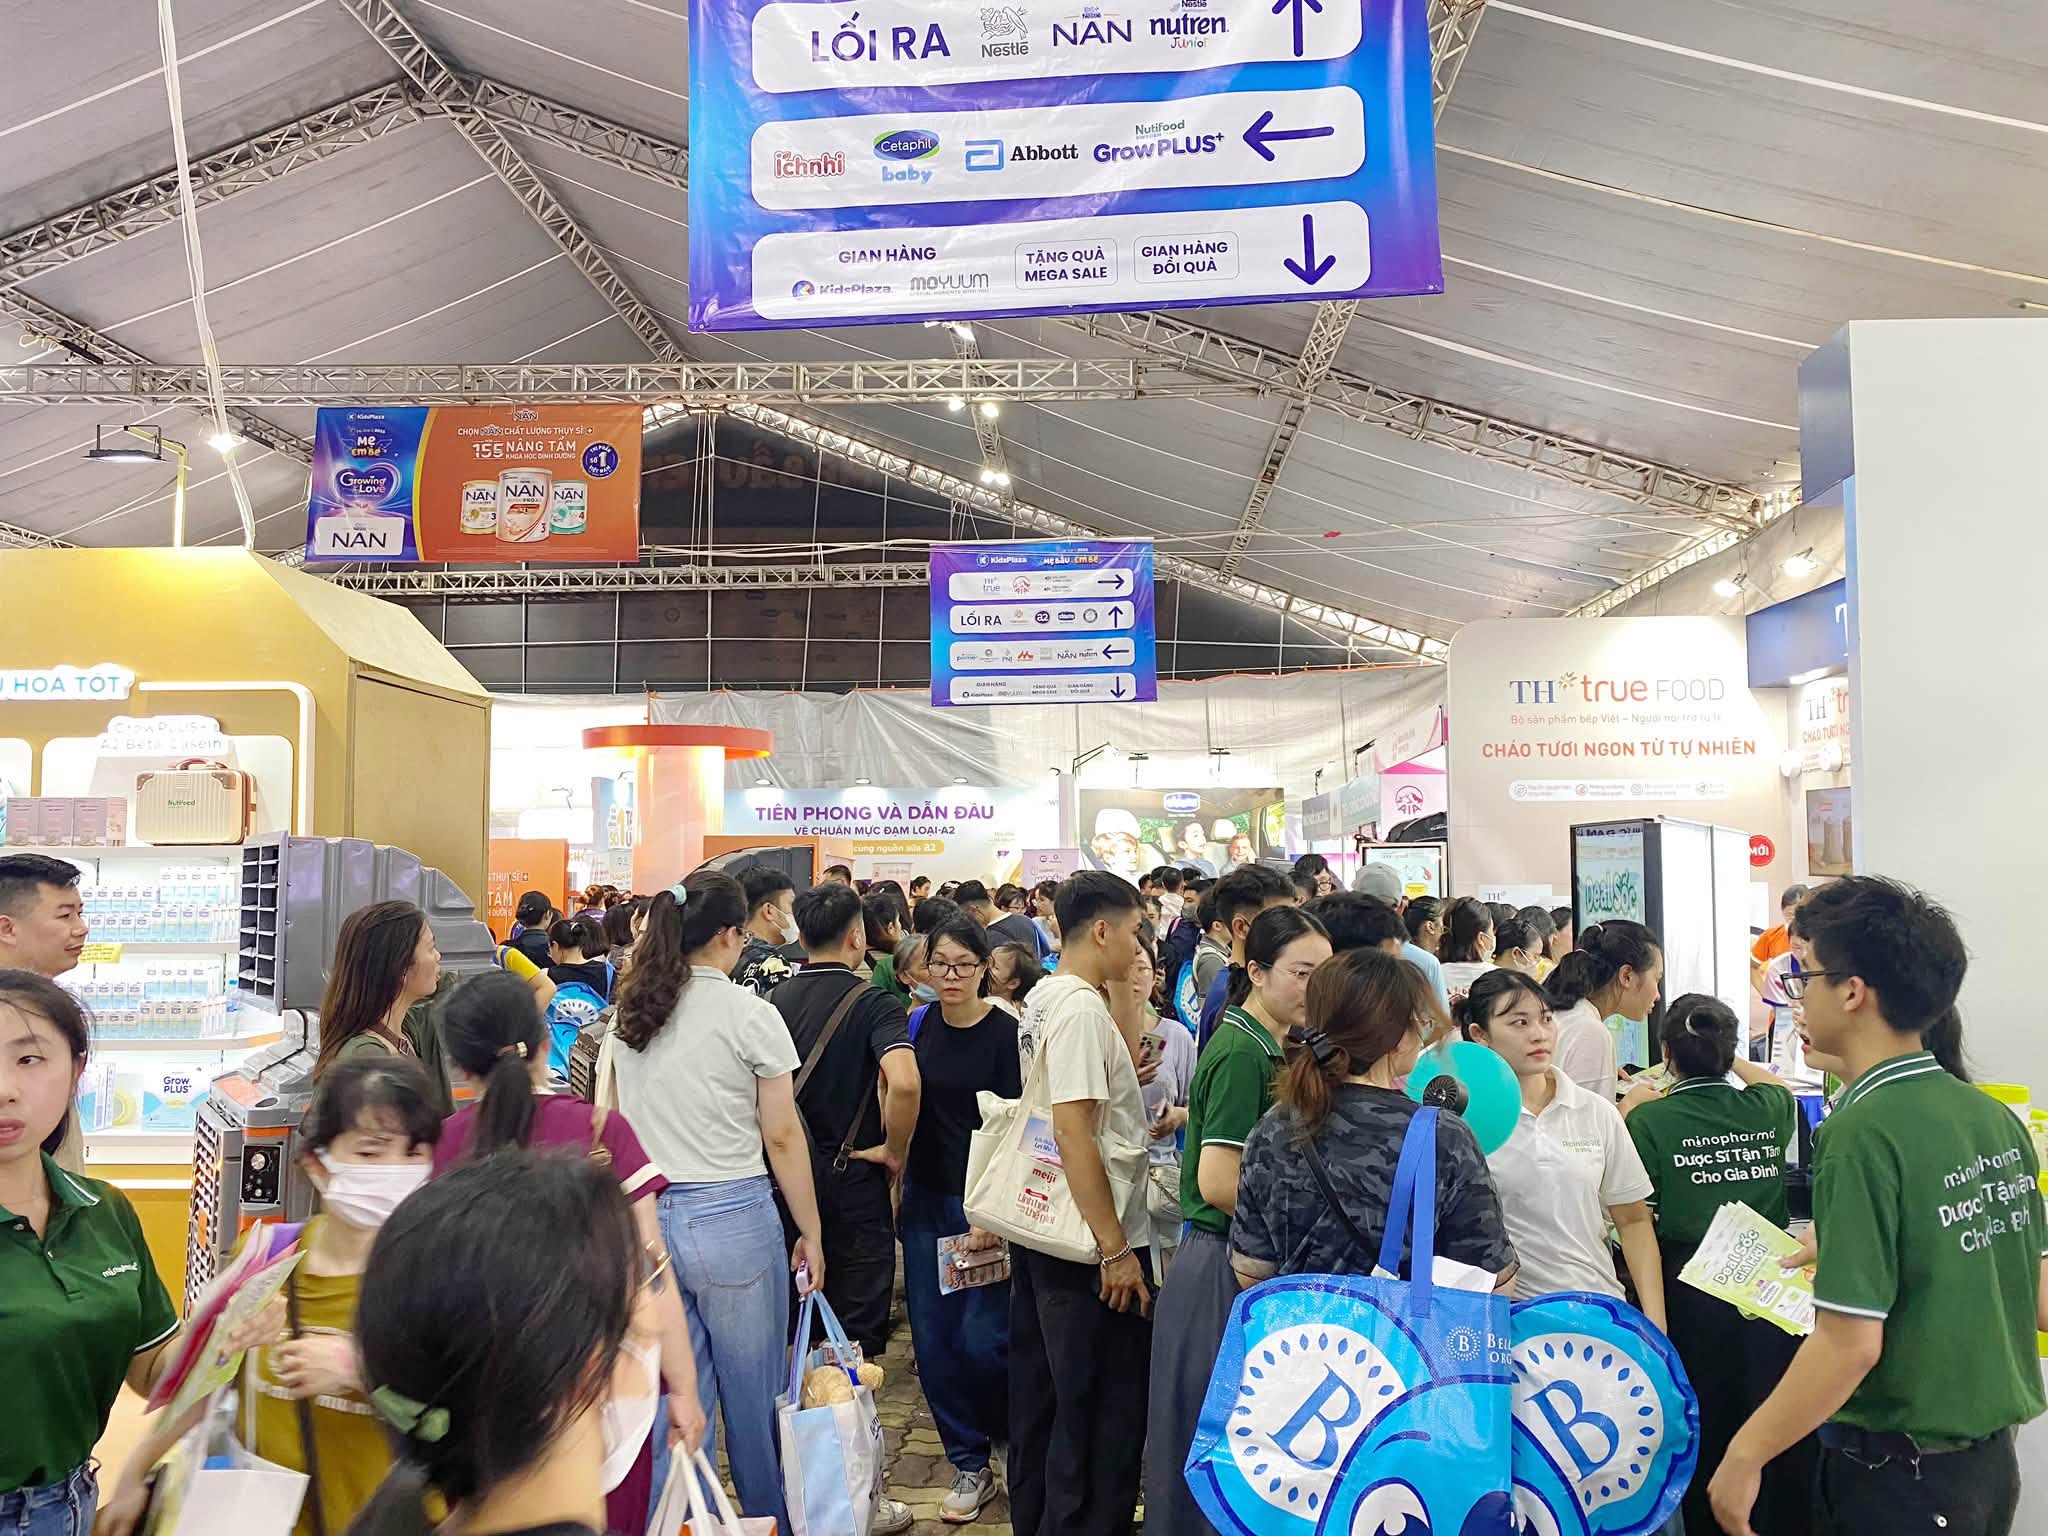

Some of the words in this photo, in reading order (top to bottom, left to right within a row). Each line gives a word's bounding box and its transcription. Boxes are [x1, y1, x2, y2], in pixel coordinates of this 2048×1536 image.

[1053, 19, 1132, 46] NAN
[1150, 14, 1227, 35] nutren
[812, 11, 877, 63] LỐI
[892, 23, 951, 61] RA
[1135, 120, 1185, 135] Nutifood
[880, 138, 932, 153] Cetaphil
[1010, 142, 1079, 162] Abbott
[882, 165, 932, 185] baby
[838, 250, 882, 264] GIAN
[886, 244, 937, 262] HÀNG
[1026, 249, 1069, 266] TẶNG
[1072, 245, 1106, 262] QUÀ
[1141, 245, 1180, 258] GIAN
[1183, 240, 1229, 256] HÀNG
[1025, 268, 1069, 283] MEGA
[1073, 266, 1107, 280] SALE
[1184, 259, 1217, 274] QUÀ
[818, 283, 893, 296] KidsPlaza
[458, 427, 480, 437] CHỌN
[472, 441, 505, 459] 155
[506, 439, 545, 452] NÂNG
[340, 472, 387, 487] Growing
[465, 491, 496, 501] NAN
[505, 485, 545, 497] NAN
[554, 490, 584, 500] NAN
[332, 532, 387, 548] NAN
[961, 610, 981, 626] LỐI
[985, 615, 1002, 625] RA
[1509, 679, 1556, 704] TH
[1581, 674, 1648, 702] true
[1655, 678, 1725, 702] FOOD
[1482, 739, 1531, 758] CHÁO
[1537, 740, 1578, 757] TƯƠI
[1584, 741, 1635, 757] NGON
[1640, 738, 1665, 756] TỪ
[1669, 740, 1694, 759] TỰ
[755, 803, 797, 821] TIÊN
[803, 805, 872, 821] PHONG
[877, 802, 901, 820] VÀ
[908, 800, 949, 819] DẪN
[954, 801, 995, 819] ĐẦU
[883, 825, 910, 838] ĐẠM
[163, 1076, 190, 1085] Grow
[1682, 1128, 1776, 1148] minopharma
[1673, 1153, 1714, 1168] Dược
[1715, 1148, 1731, 1163] Sĩ
[1731, 1148, 1761, 1163] Tận
[1032, 1167, 1057, 1184] meiji
[1691, 1170, 1721, 1185] Cho
[1724, 1167, 1750, 1182] Gia
[1751, 1163, 1779, 1179] Đình
[1713, 1252, 1740, 1285] Deal
[1734, 1229, 1760, 1256] Sốc
[1266, 1363, 1362, 1470] B
[1525, 1379, 1621, 1482] B
